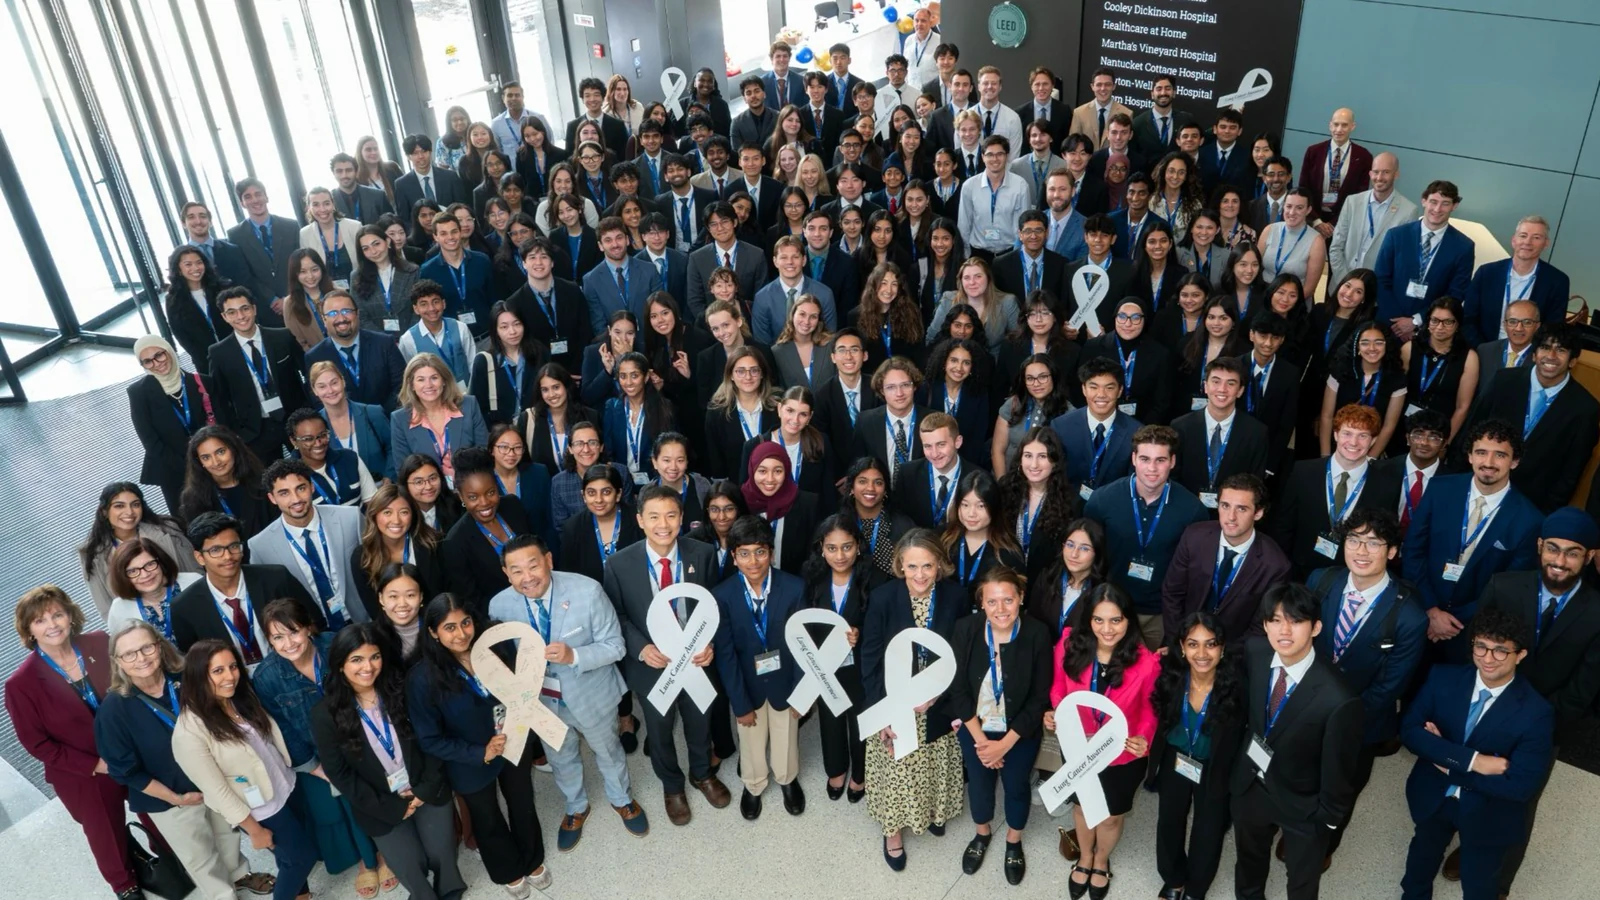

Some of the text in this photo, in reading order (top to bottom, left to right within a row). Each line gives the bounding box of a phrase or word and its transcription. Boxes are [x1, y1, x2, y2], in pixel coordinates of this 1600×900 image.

[1104, 1, 1218, 24] Cooley Dickinson Hospital
[997, 20, 1016, 31] LEED
[1102, 20, 1187, 40] Healthcare at Home
[1101, 38, 1217, 63] Martha's Vineyard Hospital
[1100, 56, 1216, 82] Nantucket Cottage Hospital
[1124, 95, 1155, 109] Hospita
[1176, 85, 1213, 100] Hospital
[659, 677, 676, 695] Lung
[670, 652, 687, 677] Cancer
[684, 620, 707, 655] Awareness
[796, 637, 807, 651] Lung
[806, 651, 821, 672] Cancer
[1053, 780, 1071, 794] Lung
[1067, 762, 1087, 780] Cancer
[1086, 736, 1114, 763] Awareness
